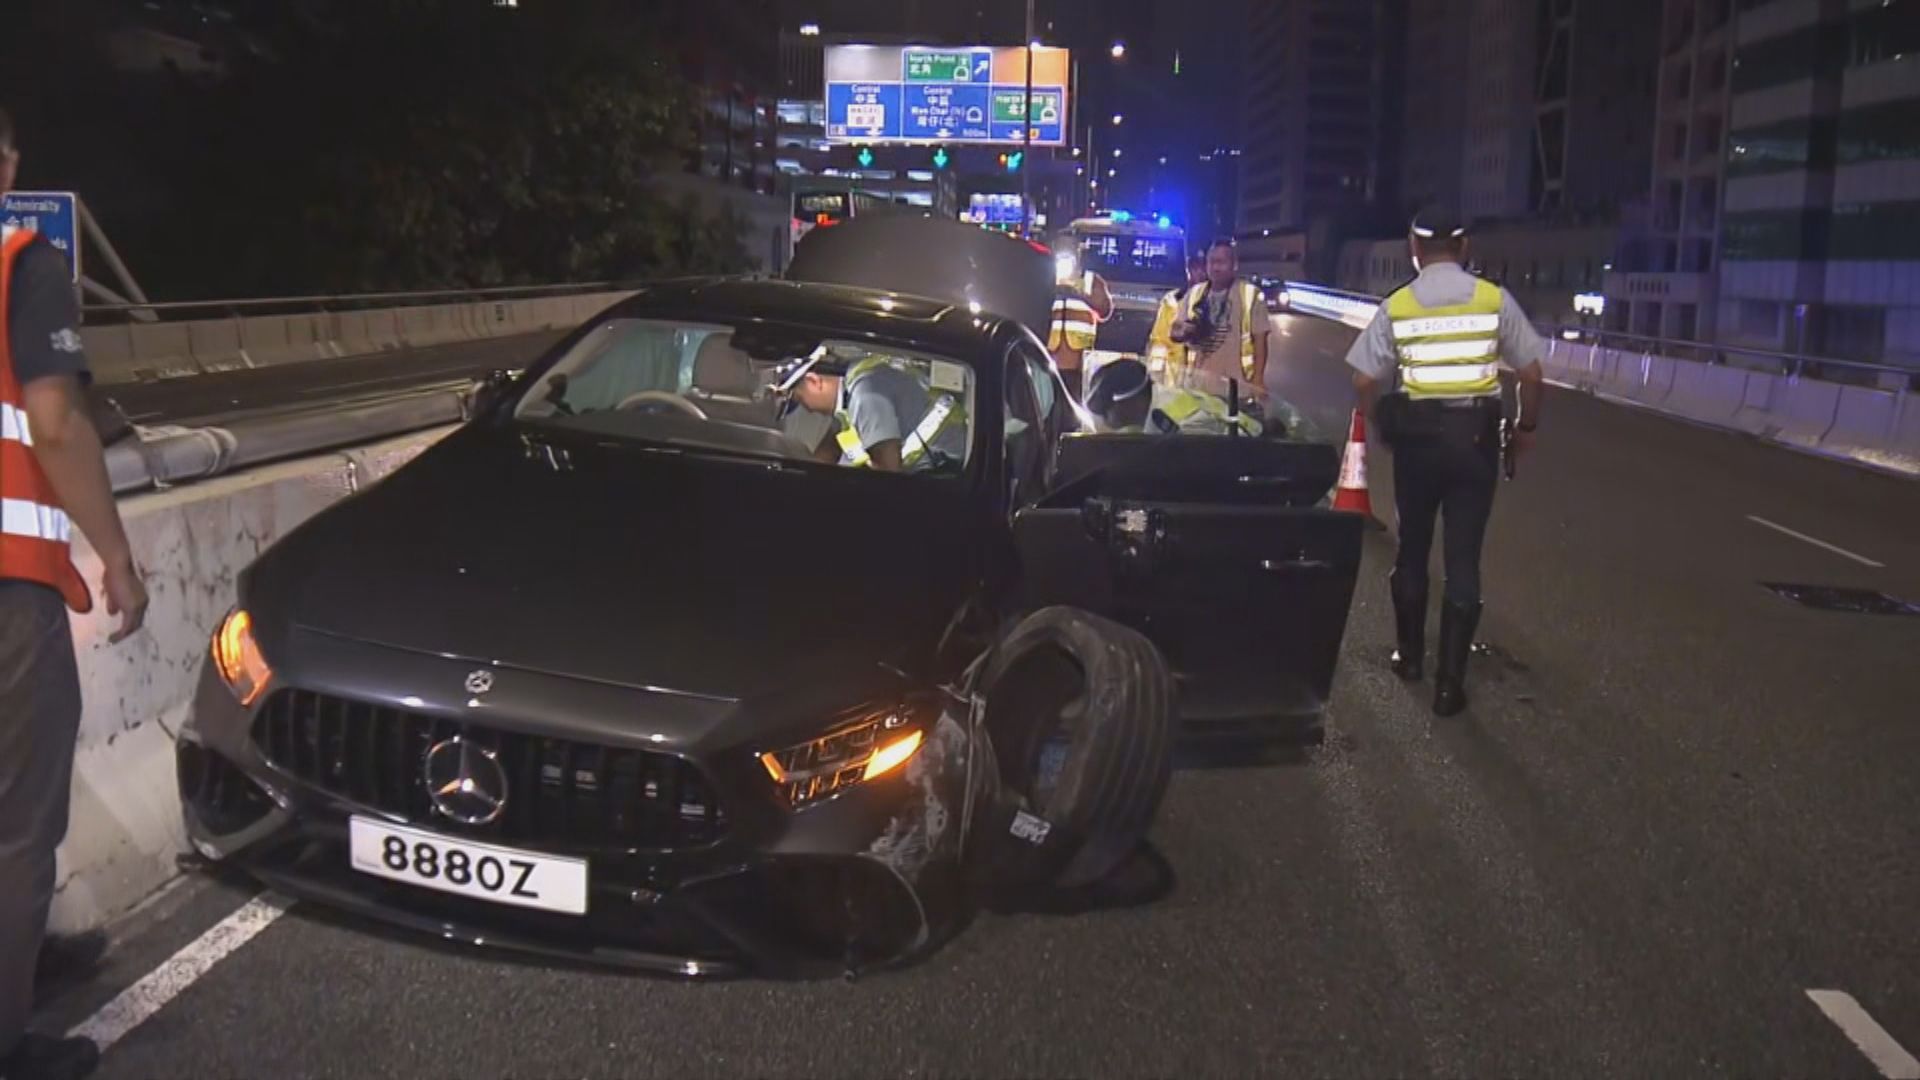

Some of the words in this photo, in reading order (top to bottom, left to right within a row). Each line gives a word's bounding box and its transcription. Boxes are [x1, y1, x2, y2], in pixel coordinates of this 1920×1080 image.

[851, 84, 881, 93] Central
[923, 86, 953, 95] Central
[6, 199, 60, 214] Admiralty
[382, 835, 539, 899] 8880Z
